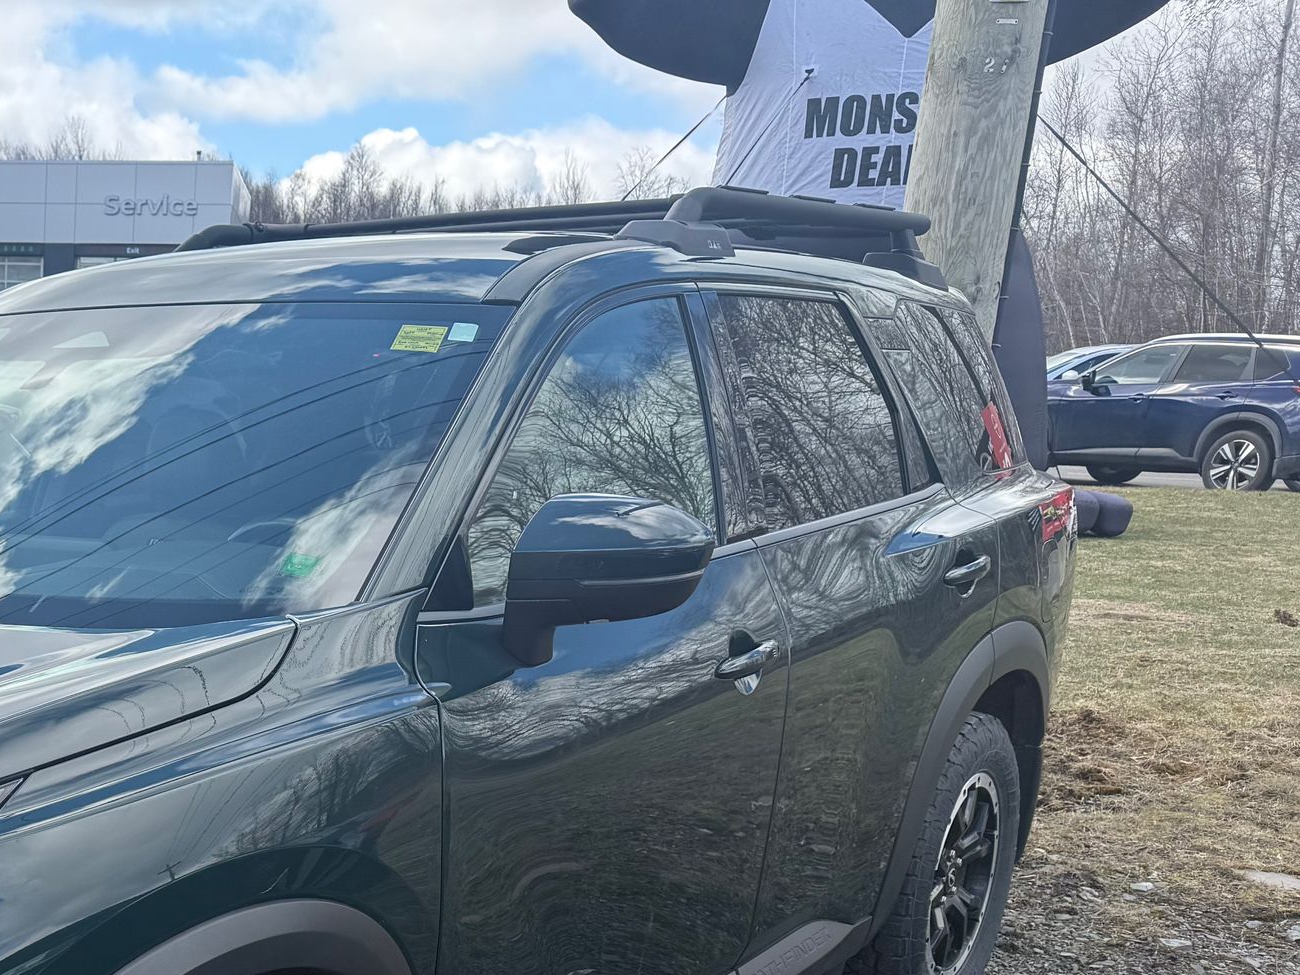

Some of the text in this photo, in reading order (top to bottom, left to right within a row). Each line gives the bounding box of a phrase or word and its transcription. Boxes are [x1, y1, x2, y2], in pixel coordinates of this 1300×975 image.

[803, 91, 919, 139] MONS
[104, 193, 198, 216] Service
[126, 247, 140, 255] Exit
